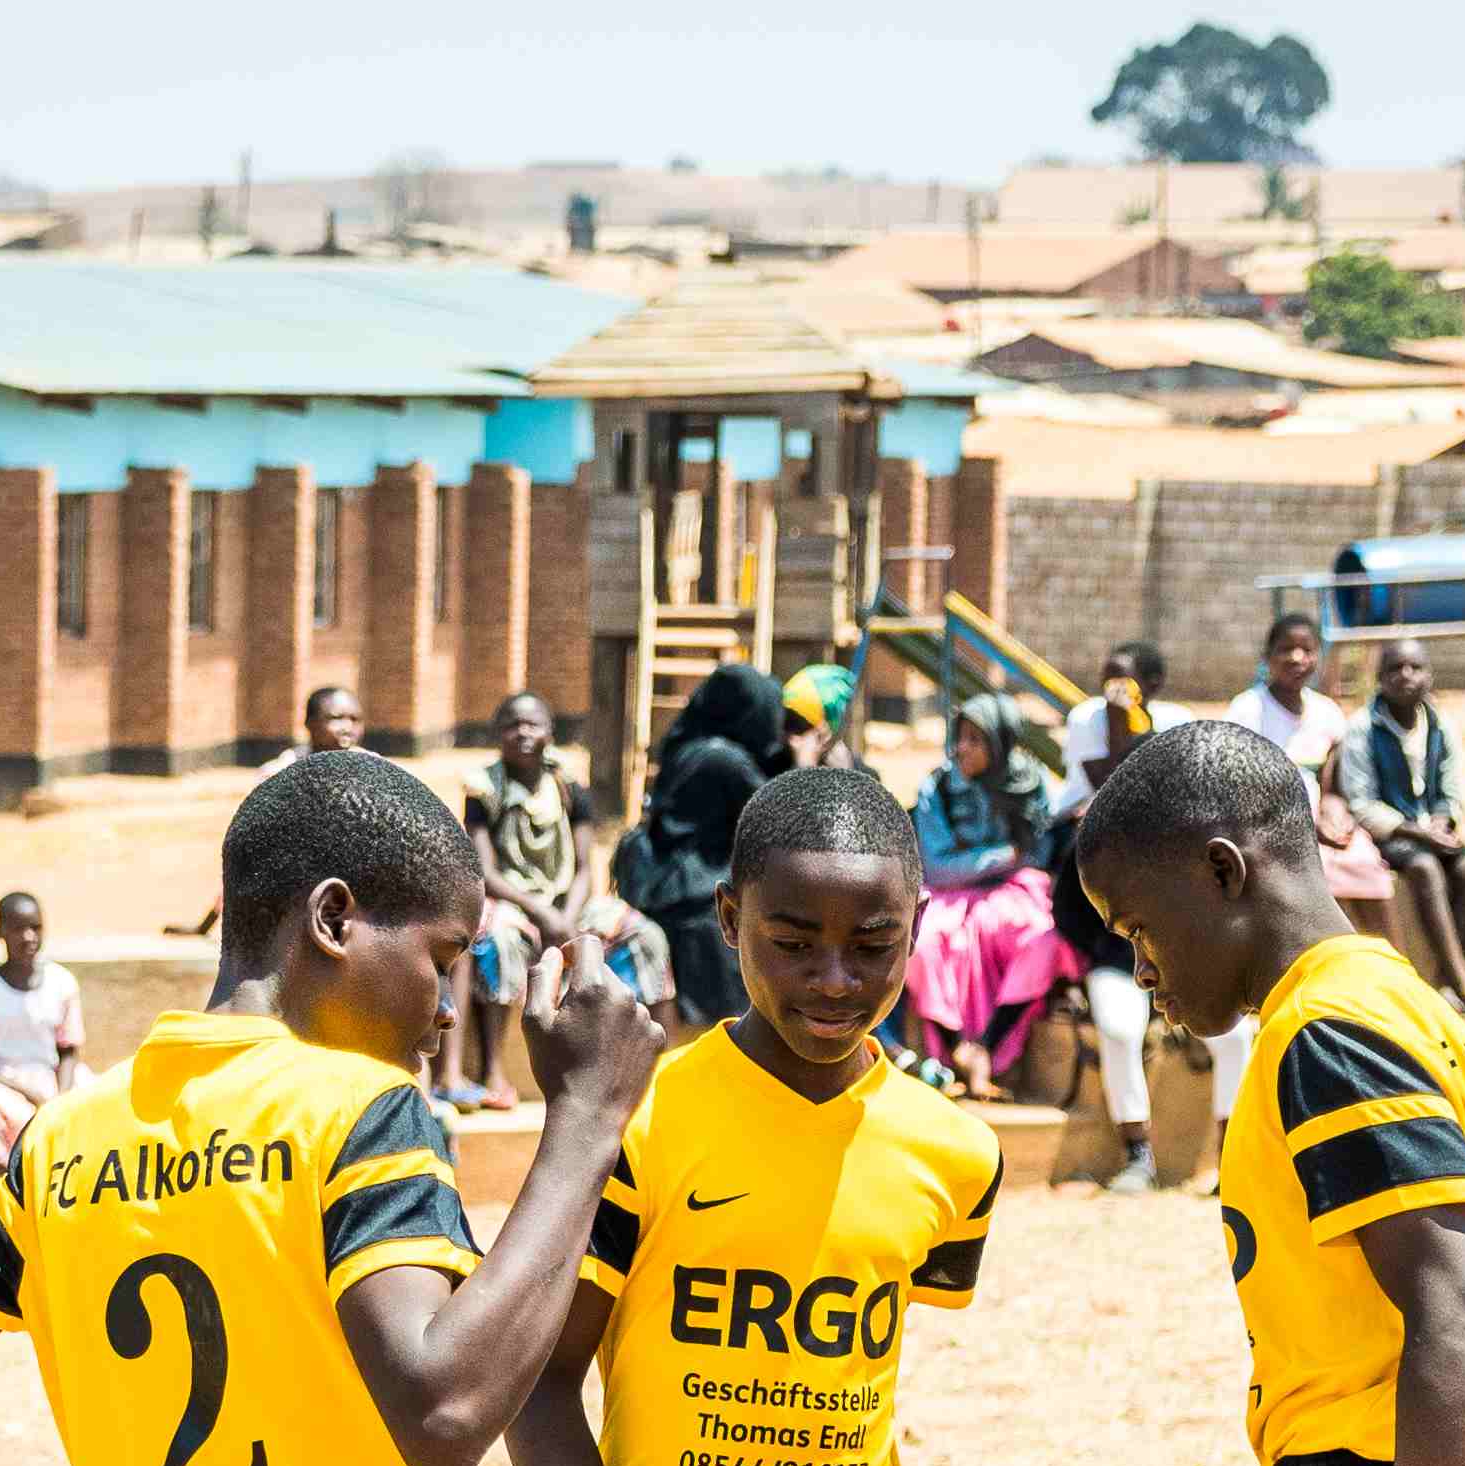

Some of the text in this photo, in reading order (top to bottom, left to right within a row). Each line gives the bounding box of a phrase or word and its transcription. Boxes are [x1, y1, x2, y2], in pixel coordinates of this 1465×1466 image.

[45, 1128, 294, 1217] FC Alkofen
[670, 1264, 900, 1360] ERGO
[682, 1372, 880, 1412] Geschäftsstelle
[697, 1412, 867, 1451] Thomas Endl
